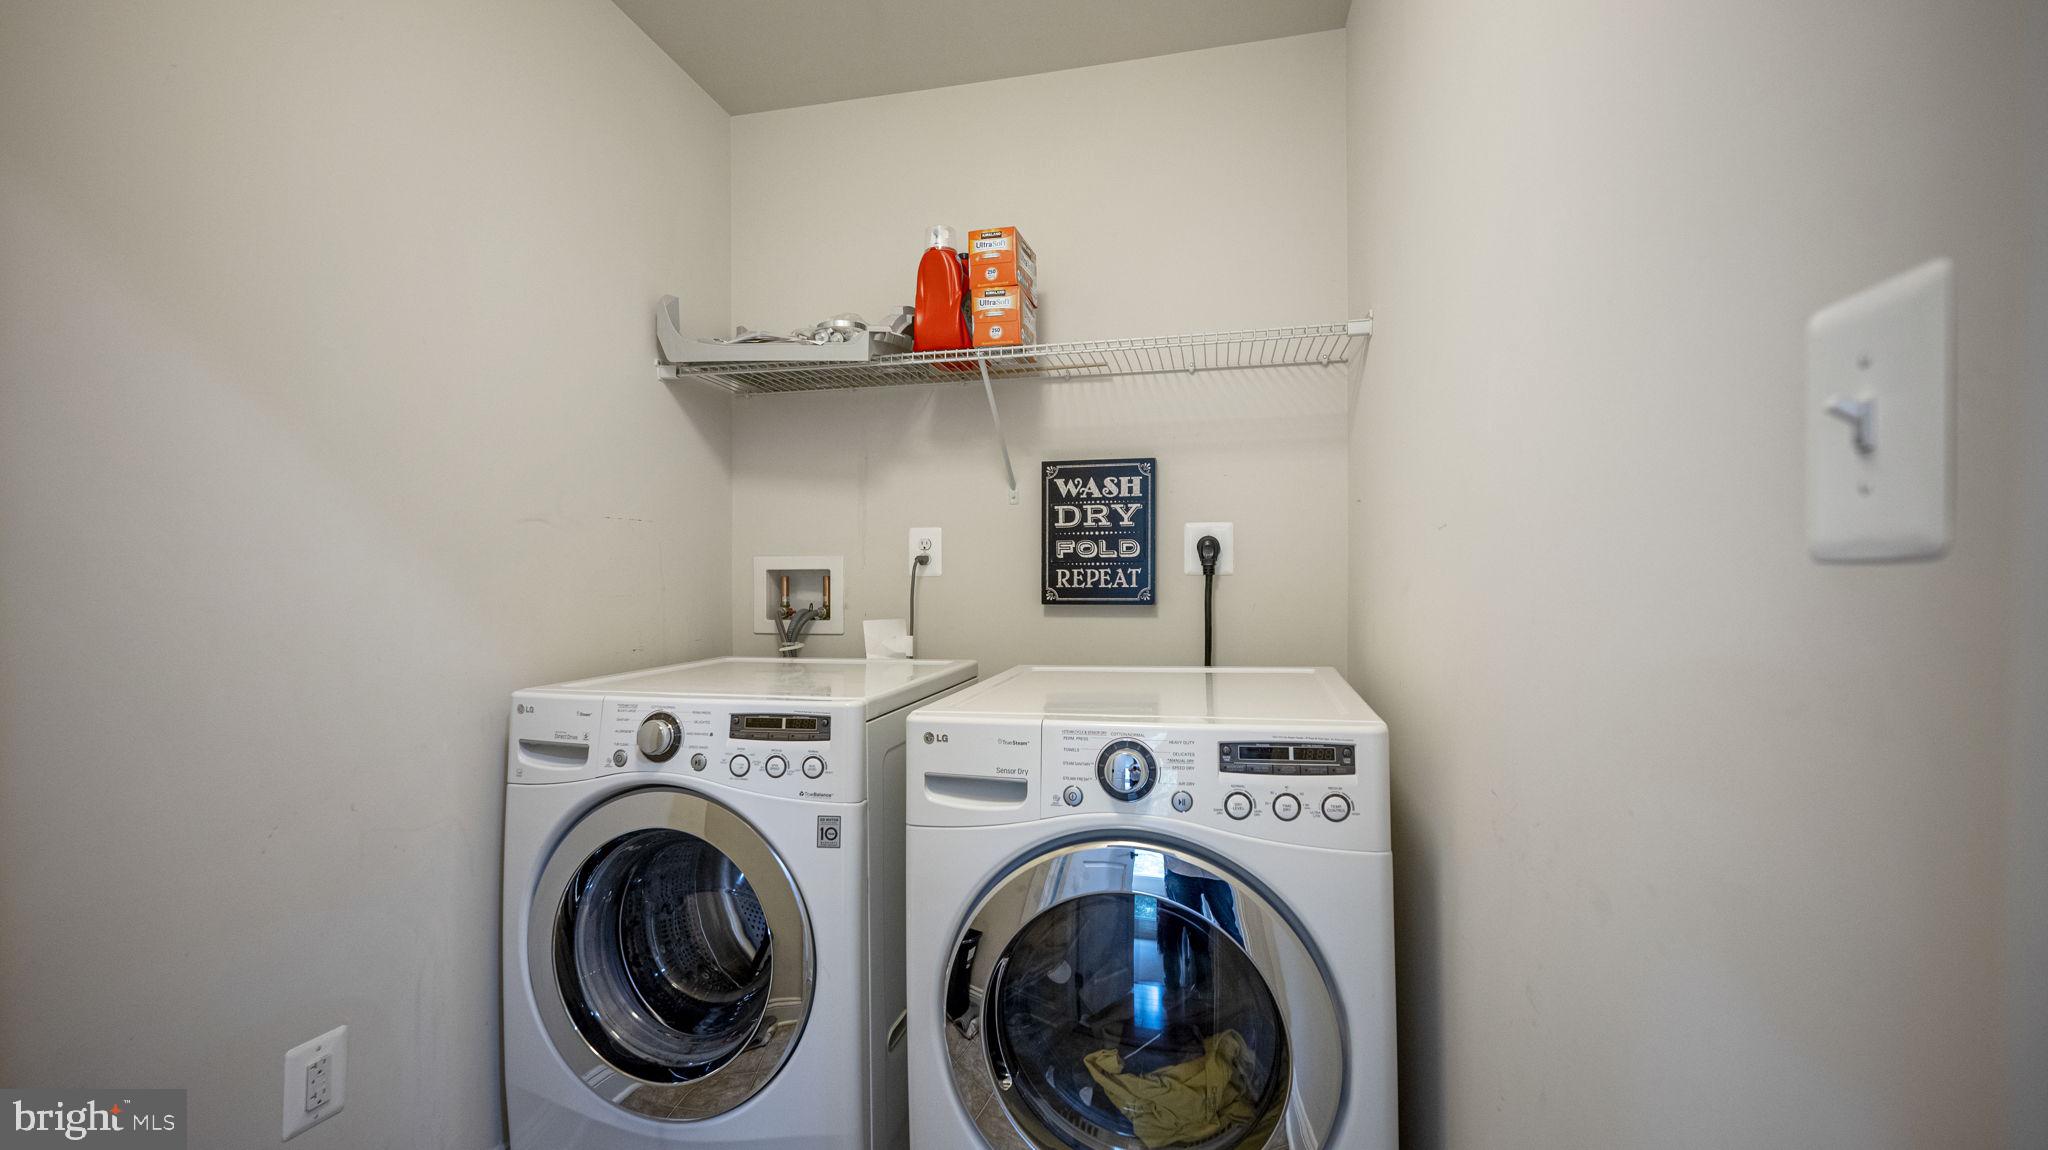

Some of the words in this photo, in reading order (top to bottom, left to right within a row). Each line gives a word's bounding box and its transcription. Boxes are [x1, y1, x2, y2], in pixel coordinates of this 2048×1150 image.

[979, 298, 1010, 307] UltraSoft
[1053, 476, 1143, 499] WASH
[1053, 503, 1144, 529] DRY
[1055, 539, 1141, 559] FOLD
[1055, 567, 1142, 589] REPEAT
[525, 706, 535, 714] LG
[936, 734, 949, 743] LG
[995, 767, 1017, 775] Sensor
[1017, 768, 1029, 776] Dry
